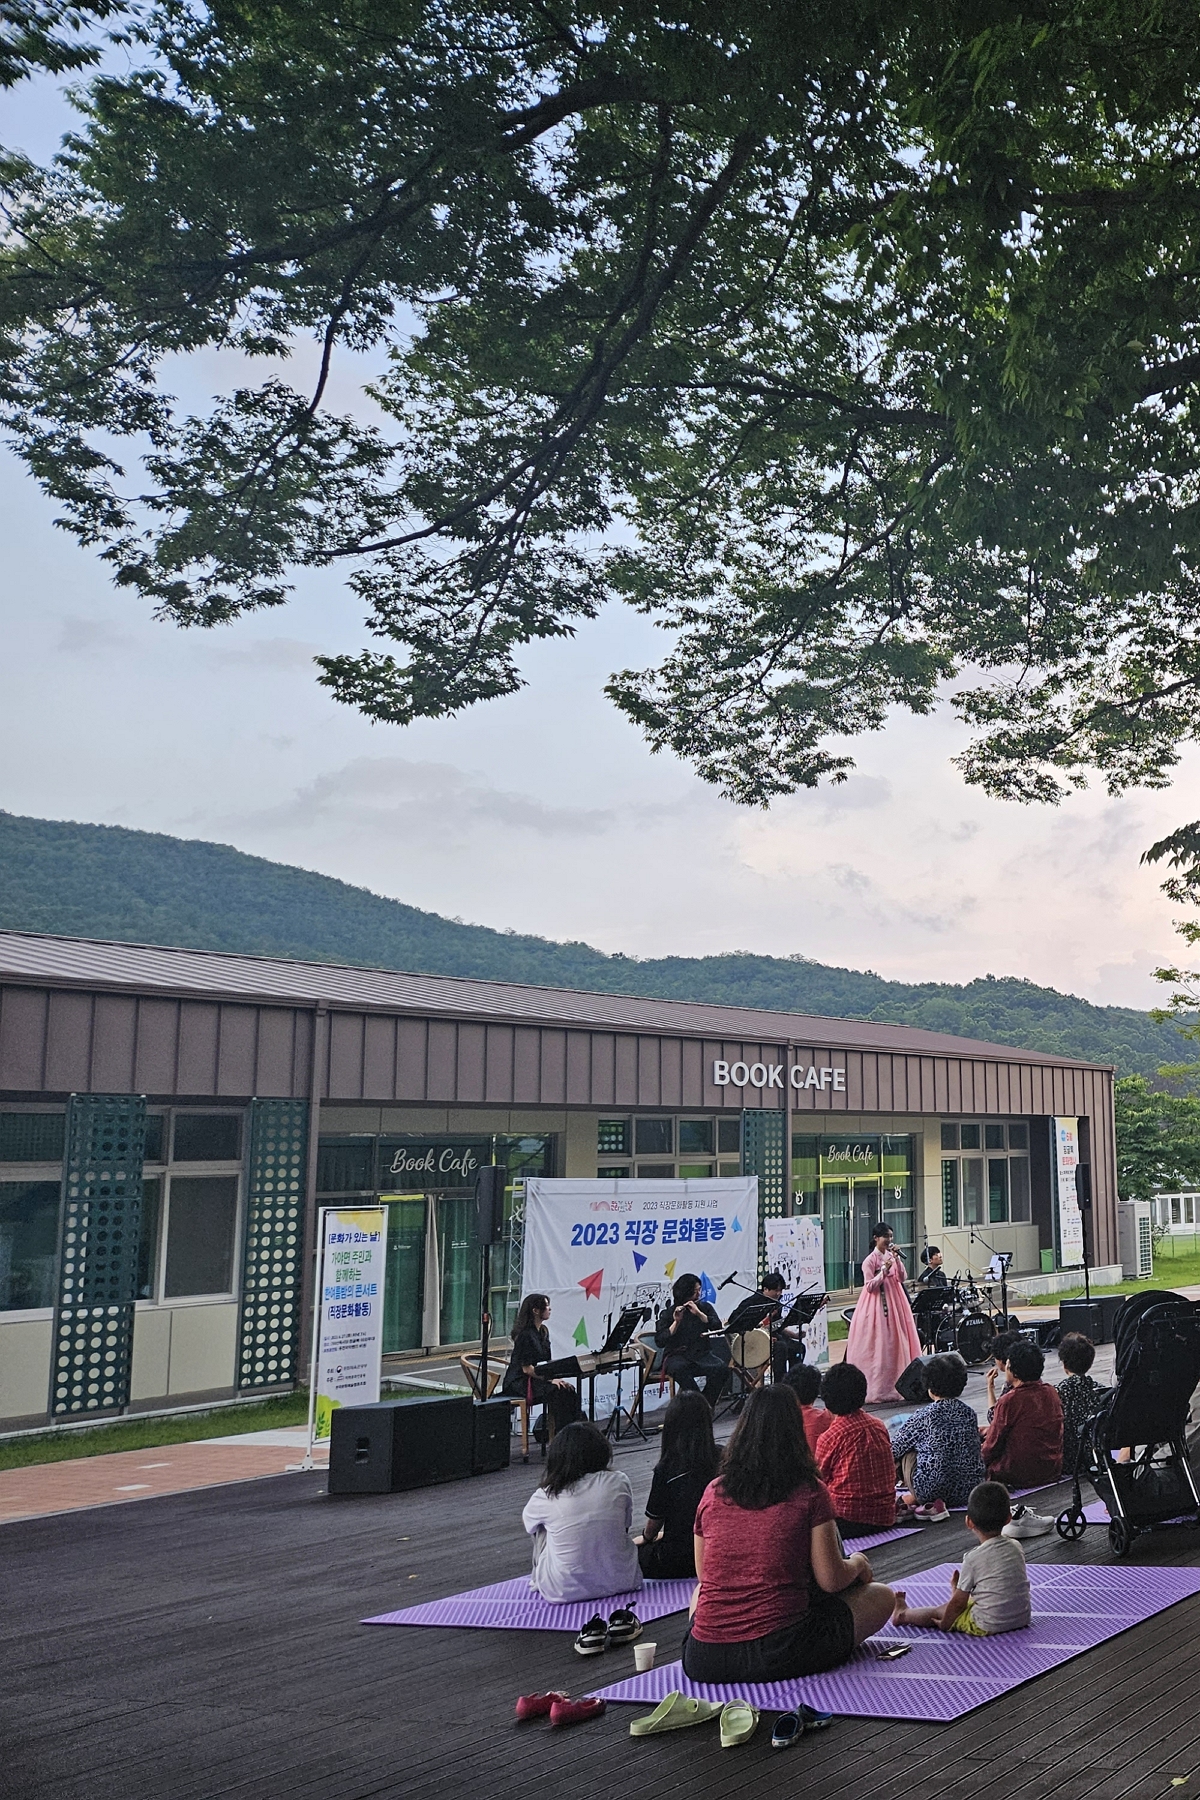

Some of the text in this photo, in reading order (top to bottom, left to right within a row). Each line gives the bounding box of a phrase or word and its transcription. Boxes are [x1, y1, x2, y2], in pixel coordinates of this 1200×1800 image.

[713, 1060, 846, 1092] BOOK CAFE
[390, 1148, 478, 1177] Book Cafe
[827, 1144, 874, 1166] Book Cafe
[642, 1201, 658, 1211] 2023
[659, 1200, 693, 1211] 직장문화활동
[328, 1231, 381, 1245] [문화가 있는 날]
[571, 1216, 727, 1246] 2023 직장 문화활동
[331, 1249, 372, 1265] 가야면 주민과
[335, 1268, 362, 1283] 함께하는
[324, 1283, 377, 1301] 한여름밤의 콘서트
[327, 1302, 372, 1320] (직장문화활동)
